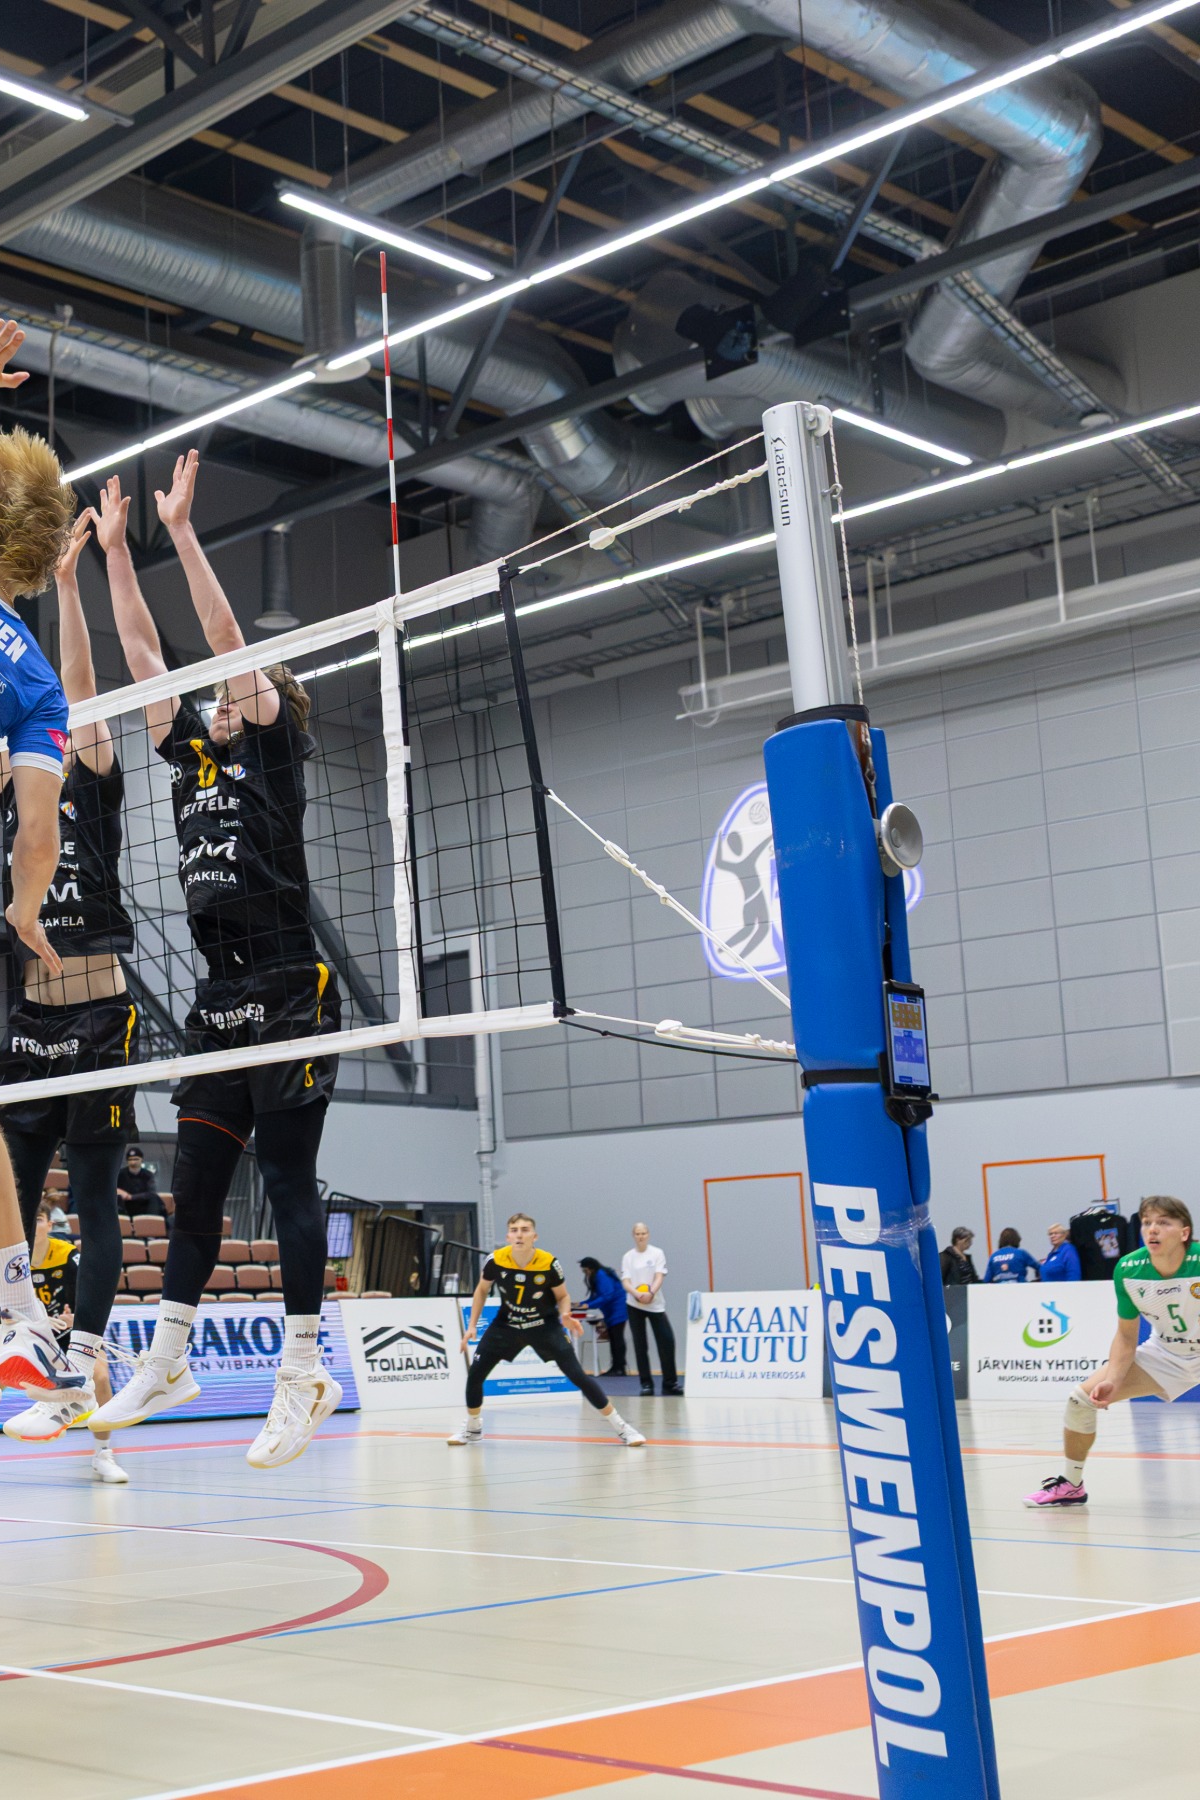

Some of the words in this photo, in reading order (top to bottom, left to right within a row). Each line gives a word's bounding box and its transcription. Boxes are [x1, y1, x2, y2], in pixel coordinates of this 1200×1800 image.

[188, 871, 237, 886] SAKELA
[110, 1105, 121, 1128] 11
[514, 1284, 526, 1305] 7
[1156, 1284, 1182, 1296] oomi
[163, 1315, 192, 1328] adidas
[702, 1306, 809, 1334] AKAAN
[1167, 1303, 1188, 1333] 5
[702, 1335, 809, 1363] SEUTU
[365, 1356, 449, 1372] TOIJALAN
[977, 1356, 1042, 1373] JÄRVINEN
[1046, 1356, 1098, 1371] YHTIÖT
[367, 1373, 439, 1384] RAKENNUSTARVIKE
[440, 1372, 451, 1381] OY
[702, 1369, 746, 1380] KENTÄLLÄ
[747, 1371, 758, 1380] JA
[760, 1370, 806, 1380] VERKOSSA
[813, 1182, 948, 1768] PESMENPOL
